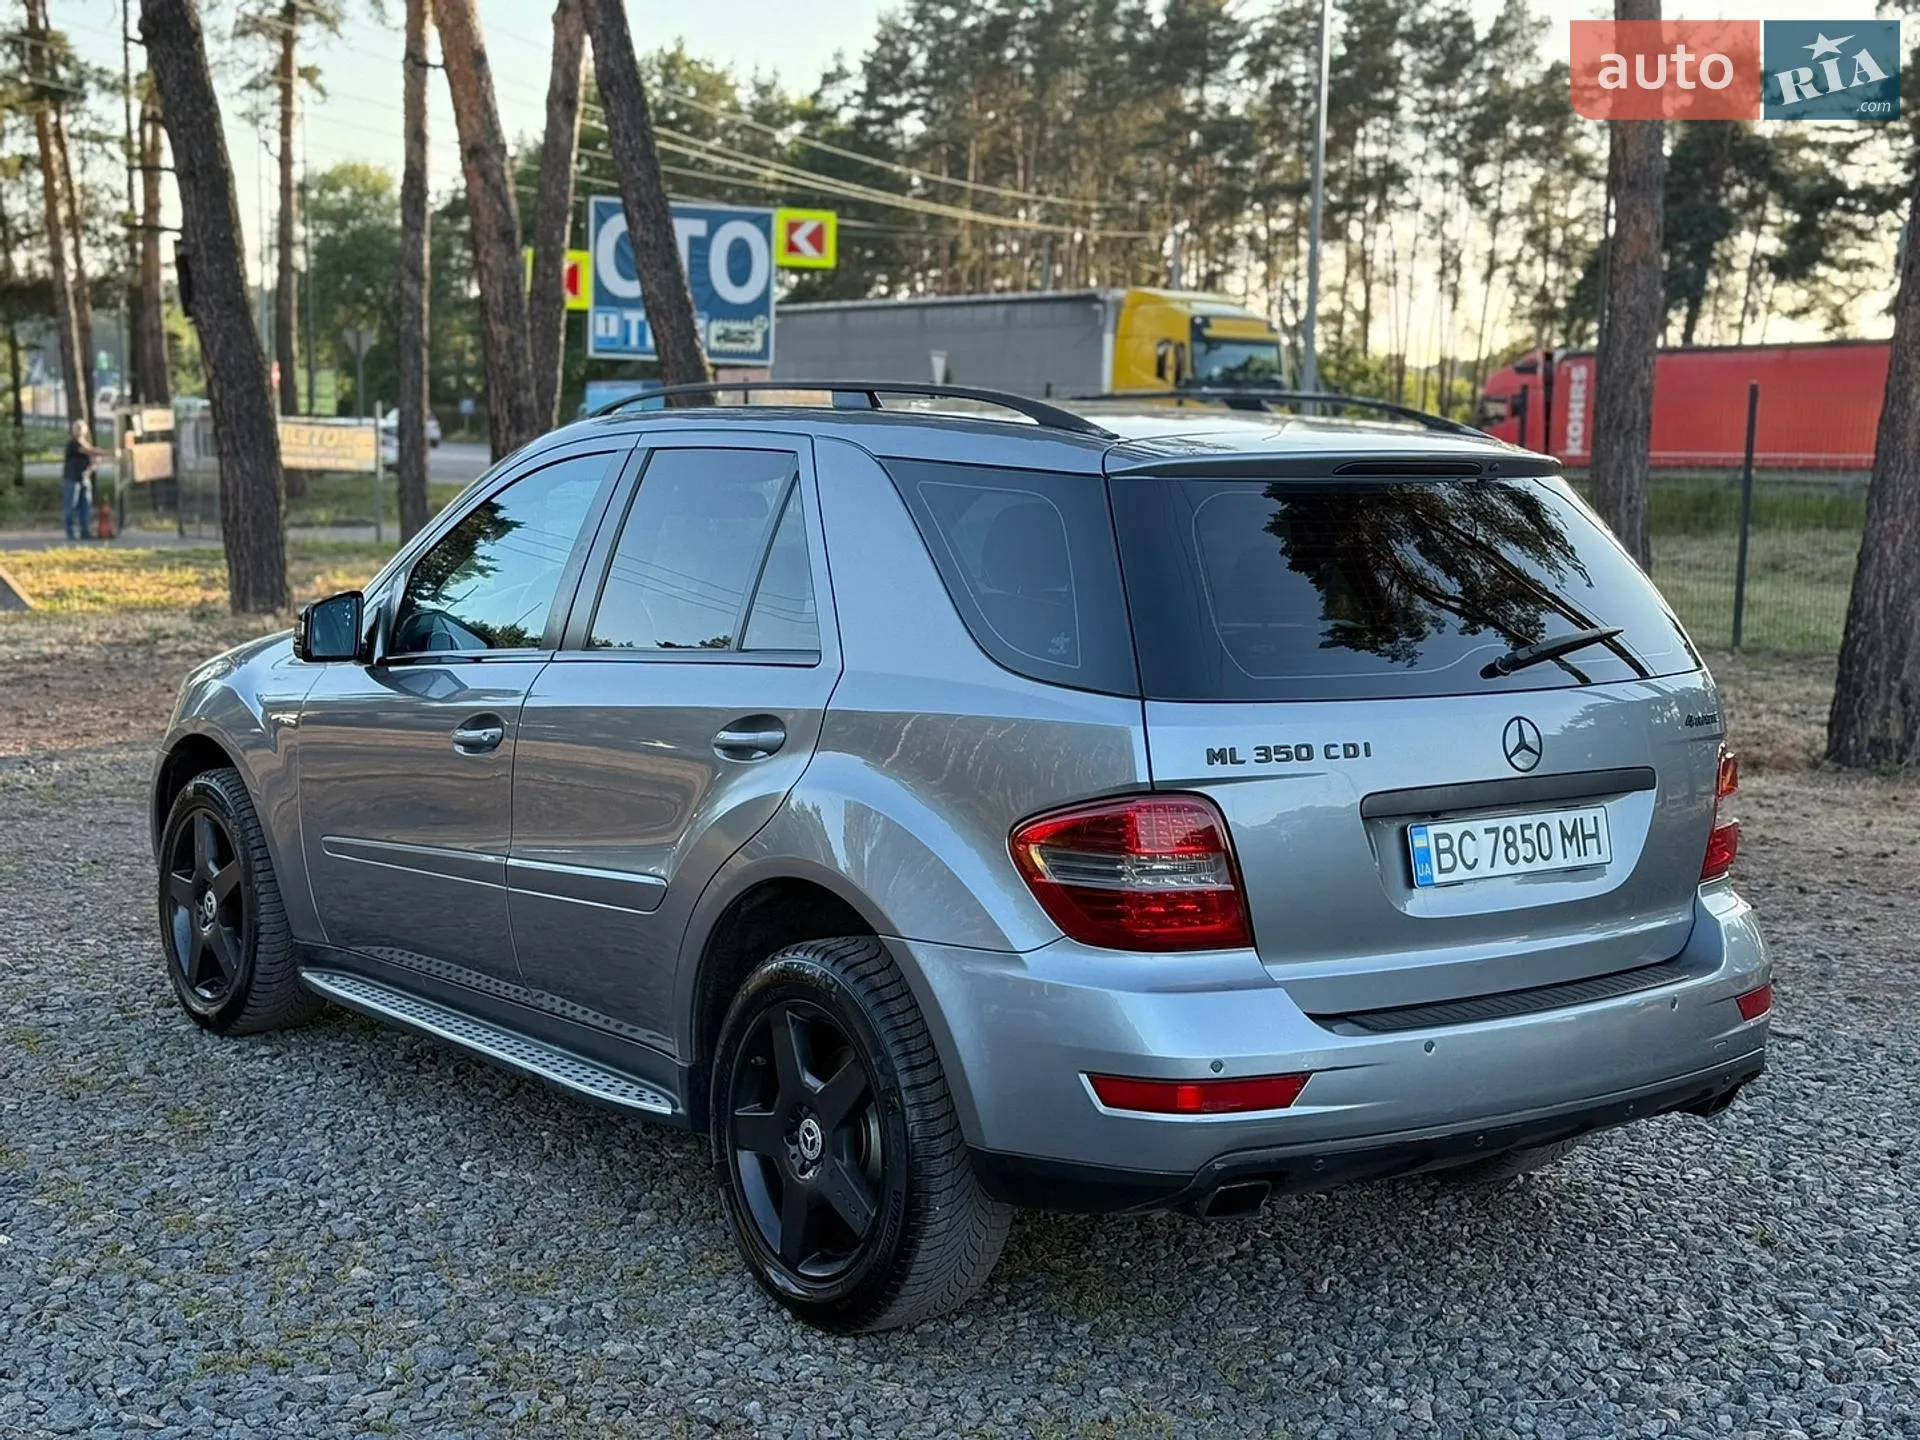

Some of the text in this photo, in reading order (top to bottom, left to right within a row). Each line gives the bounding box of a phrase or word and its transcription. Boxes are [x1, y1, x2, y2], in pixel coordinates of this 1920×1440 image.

[1205, 741, 1372, 766] ML 350 CDI
[1433, 815, 1602, 875] BC 7850 MH
[1417, 863, 1432, 878] UA
